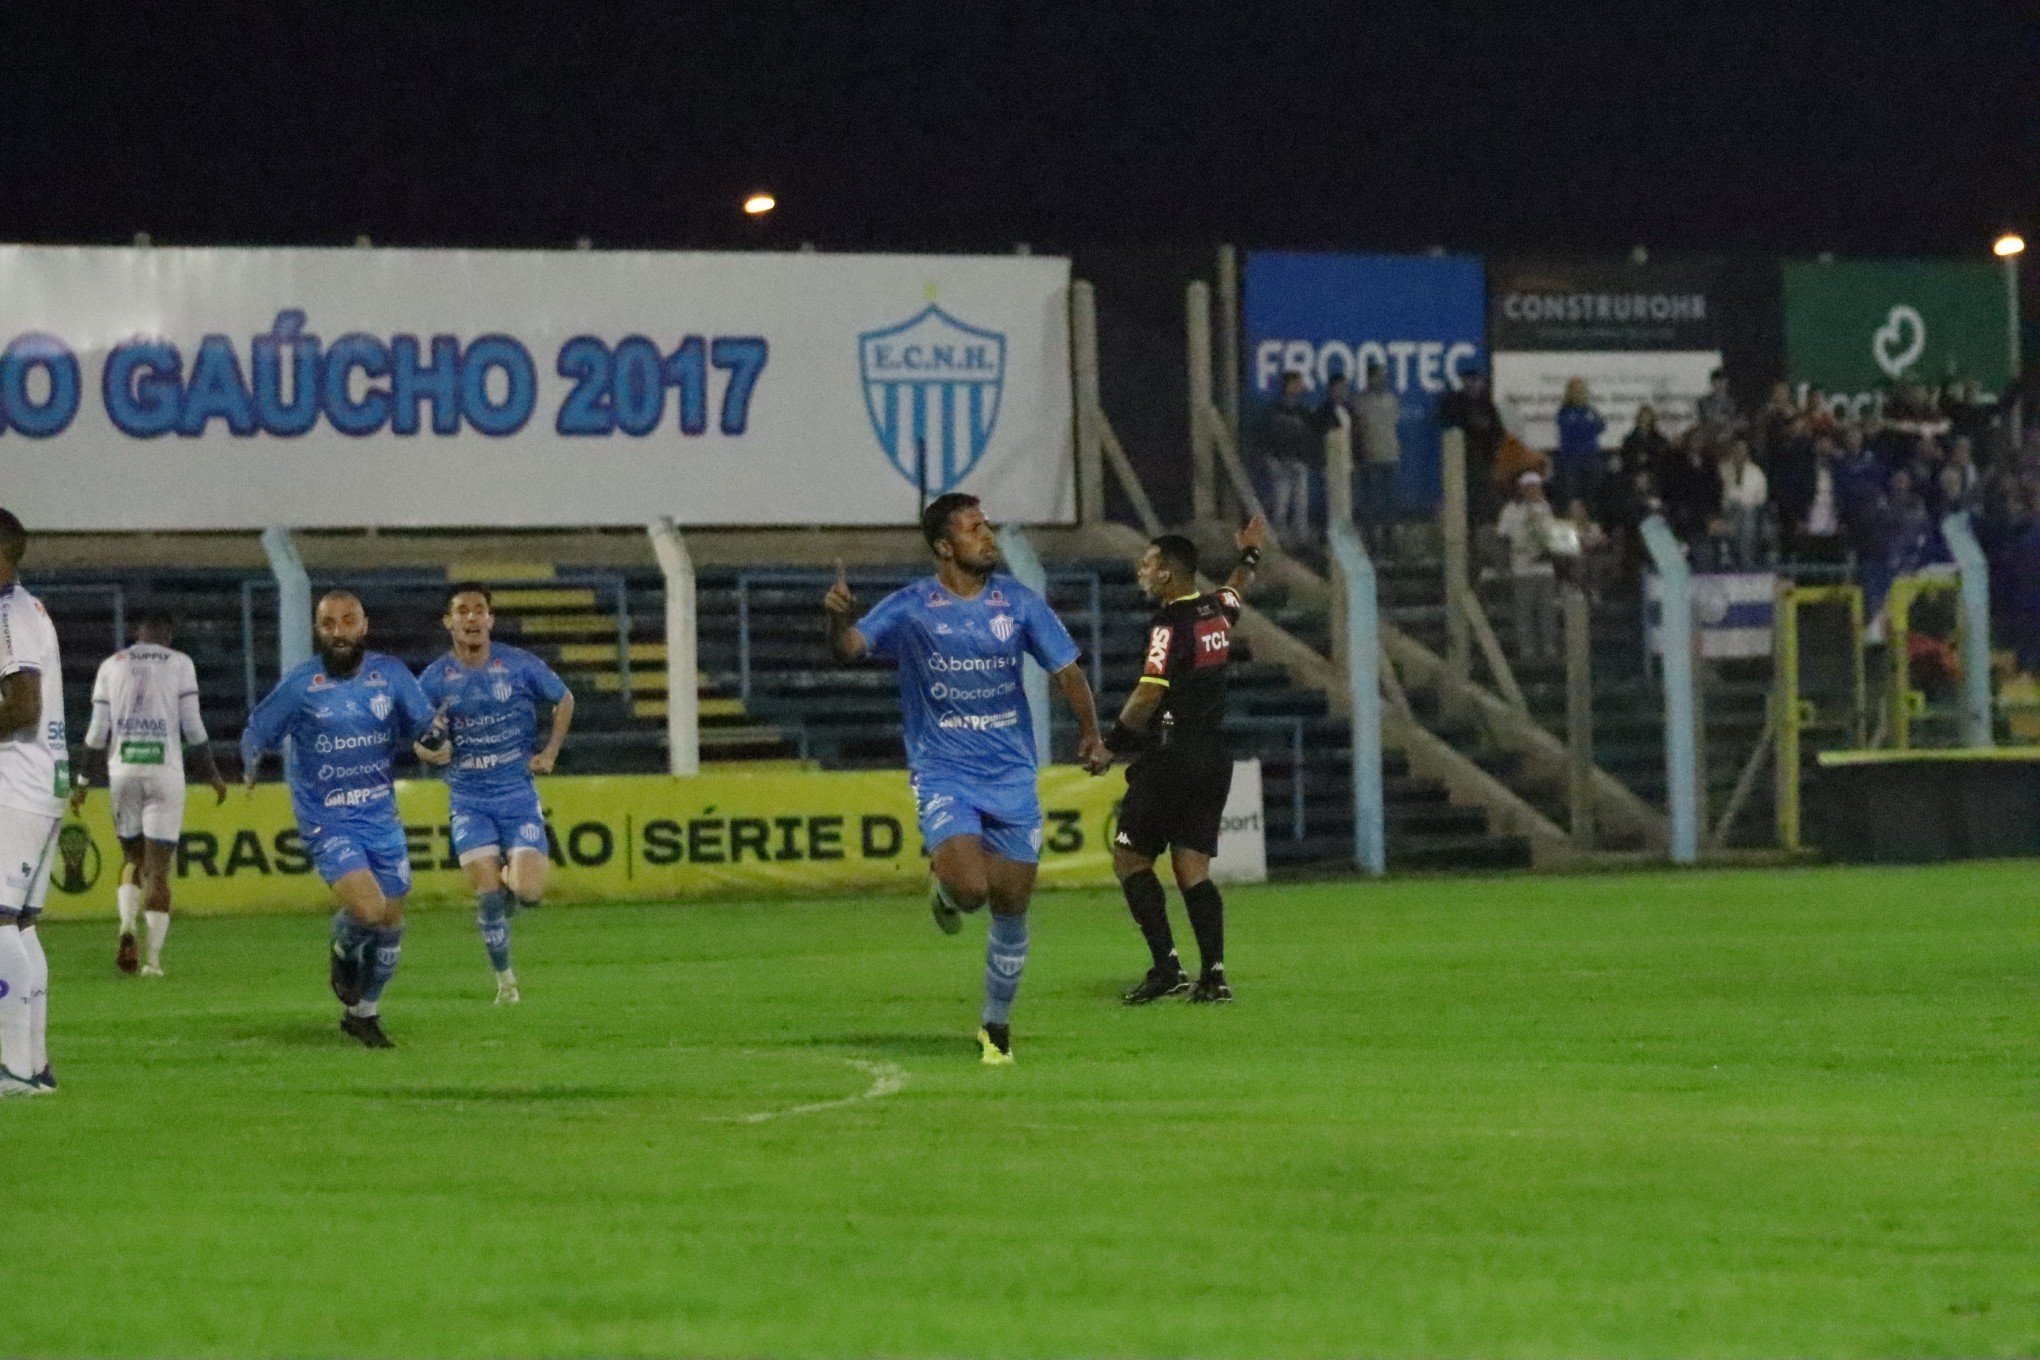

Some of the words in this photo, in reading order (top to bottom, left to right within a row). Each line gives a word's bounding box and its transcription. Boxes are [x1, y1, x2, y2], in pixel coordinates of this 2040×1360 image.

[0, 333, 83, 438] O
[103, 307, 538, 439] GAÚCHO
[556, 334, 768, 437] 2017
[1147, 625, 1171, 676] SKY
[1201, 630, 1230, 653] TCL
[642, 804, 844, 866] SÉRIE
[861, 814, 903, 858] D
